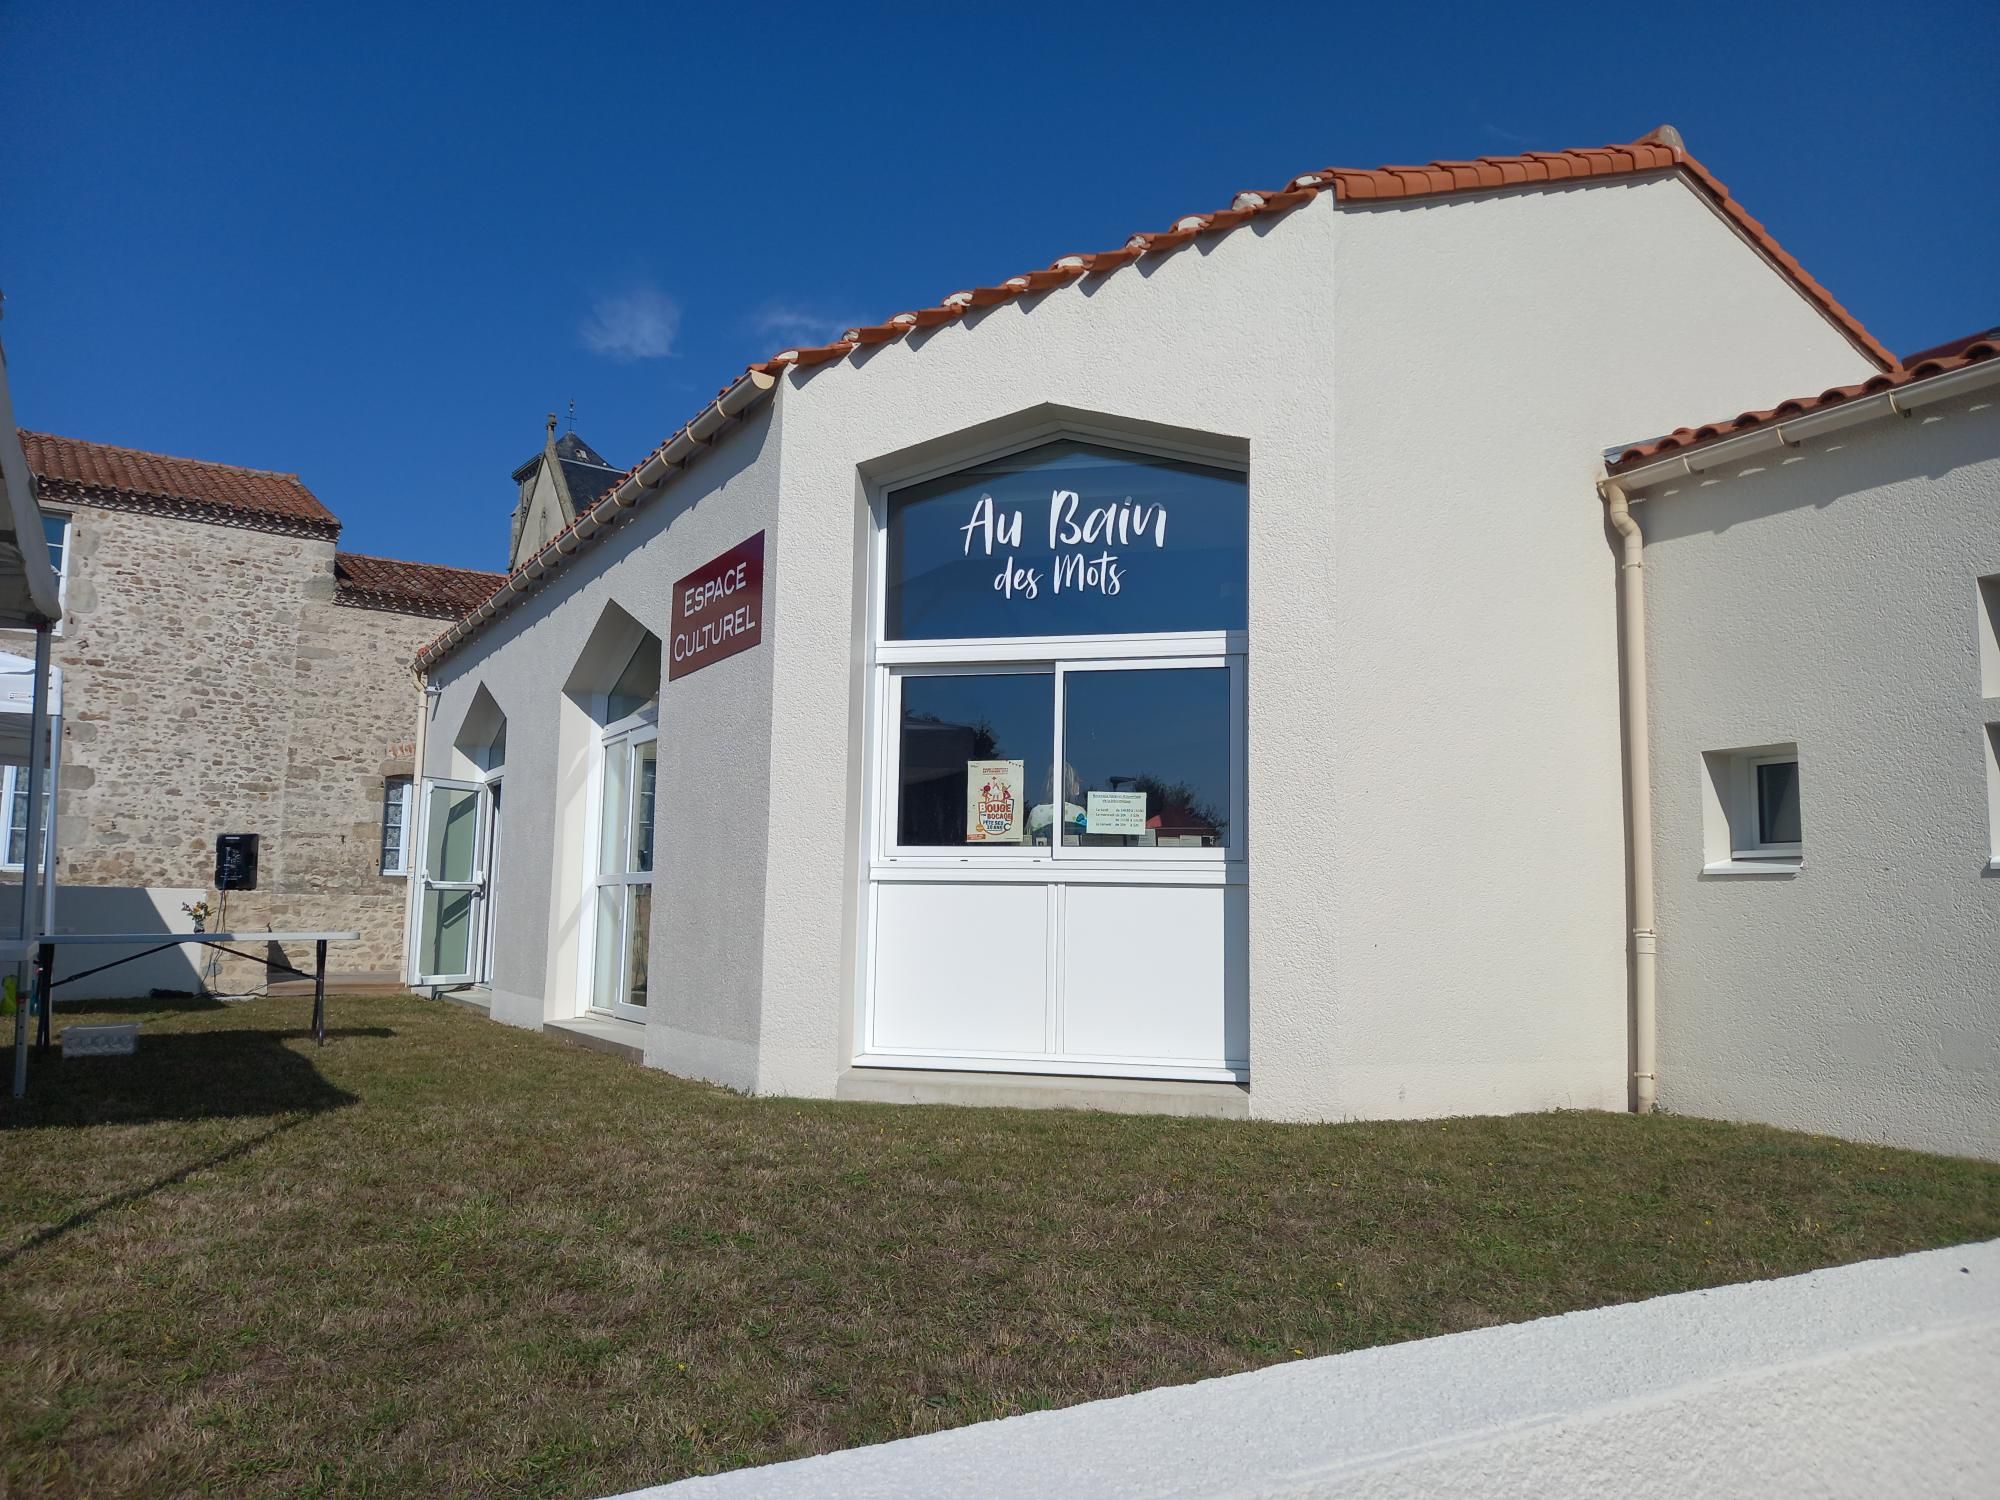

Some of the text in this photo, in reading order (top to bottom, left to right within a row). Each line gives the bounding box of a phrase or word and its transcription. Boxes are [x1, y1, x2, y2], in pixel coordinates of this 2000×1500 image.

[960, 490, 1167, 556] Au Bain
[684, 561, 747, 618] ESPACE
[993, 550, 1127, 600] des Mots
[674, 605, 756, 662] CULTUREL
